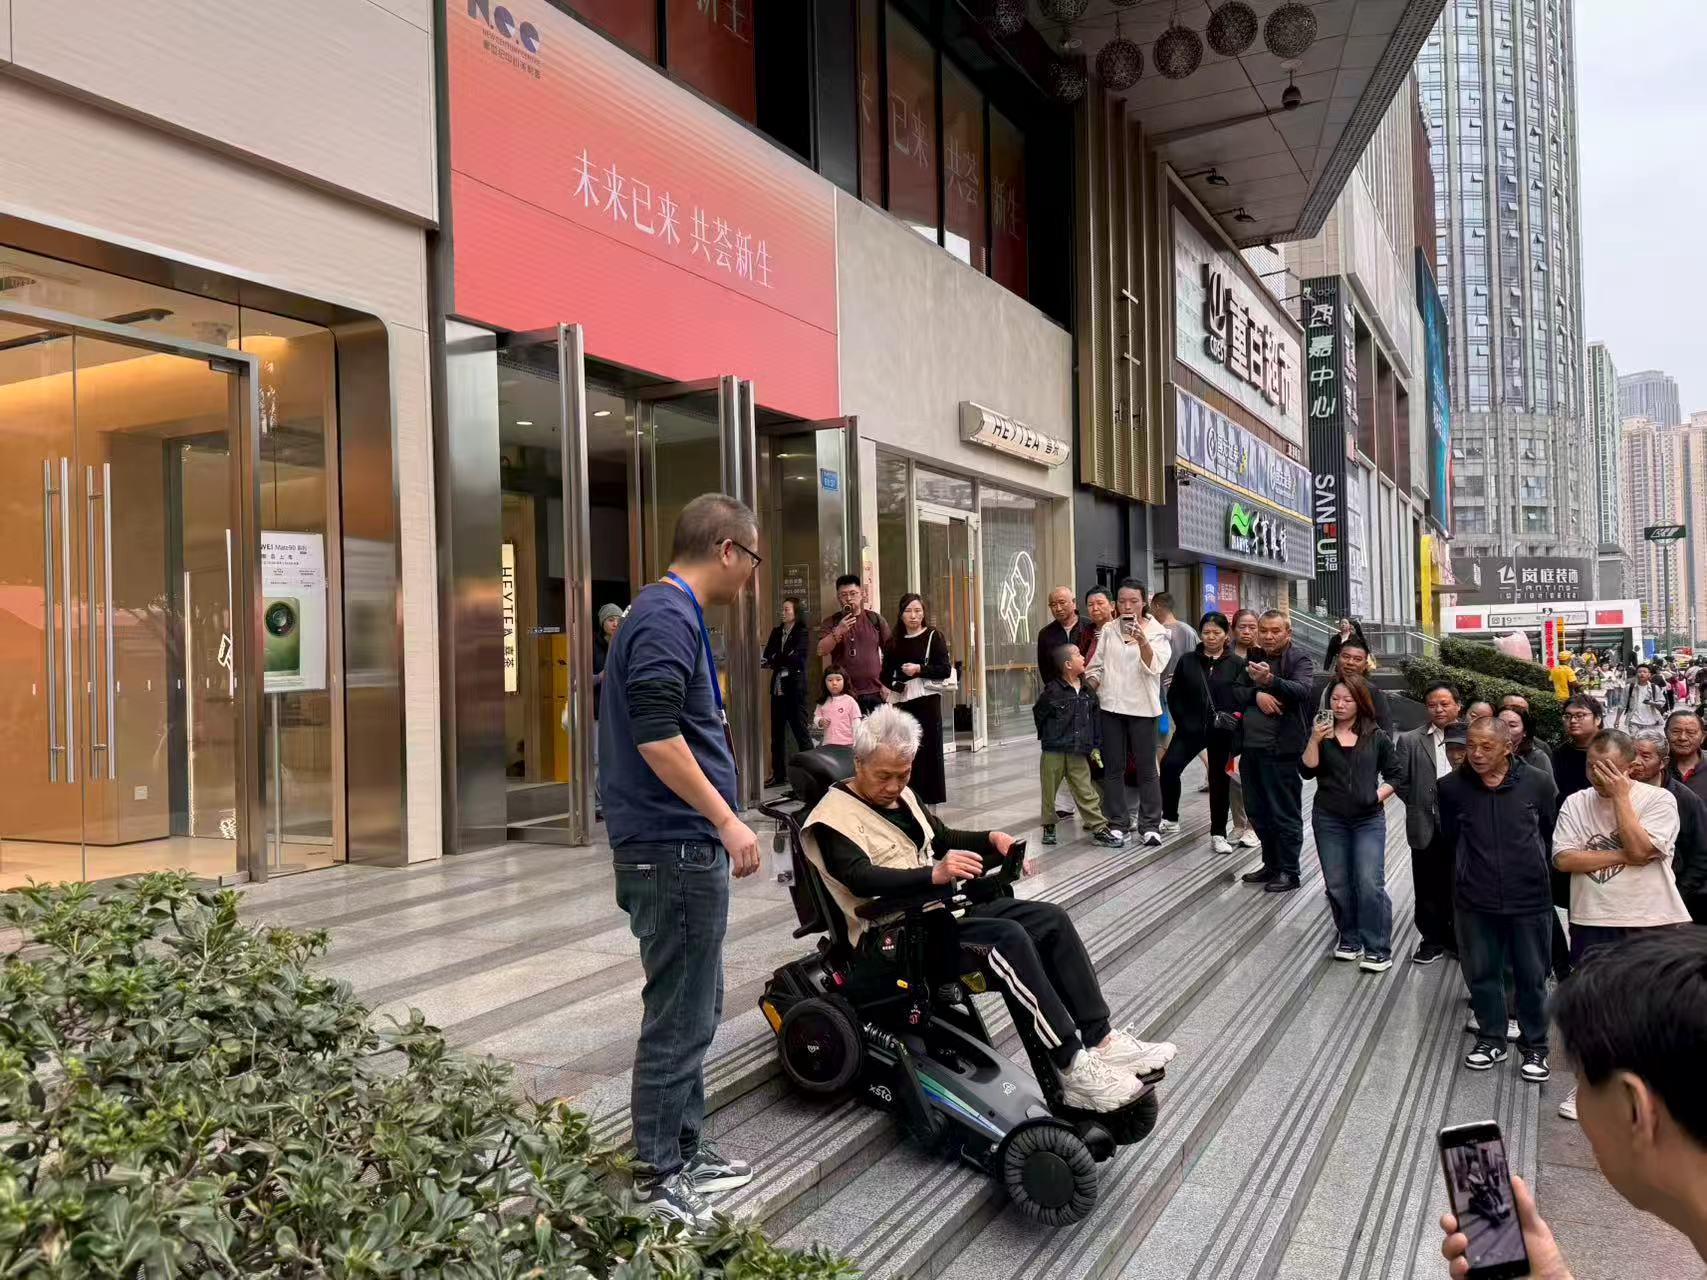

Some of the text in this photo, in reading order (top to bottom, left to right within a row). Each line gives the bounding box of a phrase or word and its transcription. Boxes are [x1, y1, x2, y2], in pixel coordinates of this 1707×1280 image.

[573, 149, 775, 289] 未来已来 共荟新生
[993, 414, 1040, 451] HEYTEA
[502, 567, 514, 637] HEYTEA
[1521, 568, 1579, 584] 岚庭装饰
